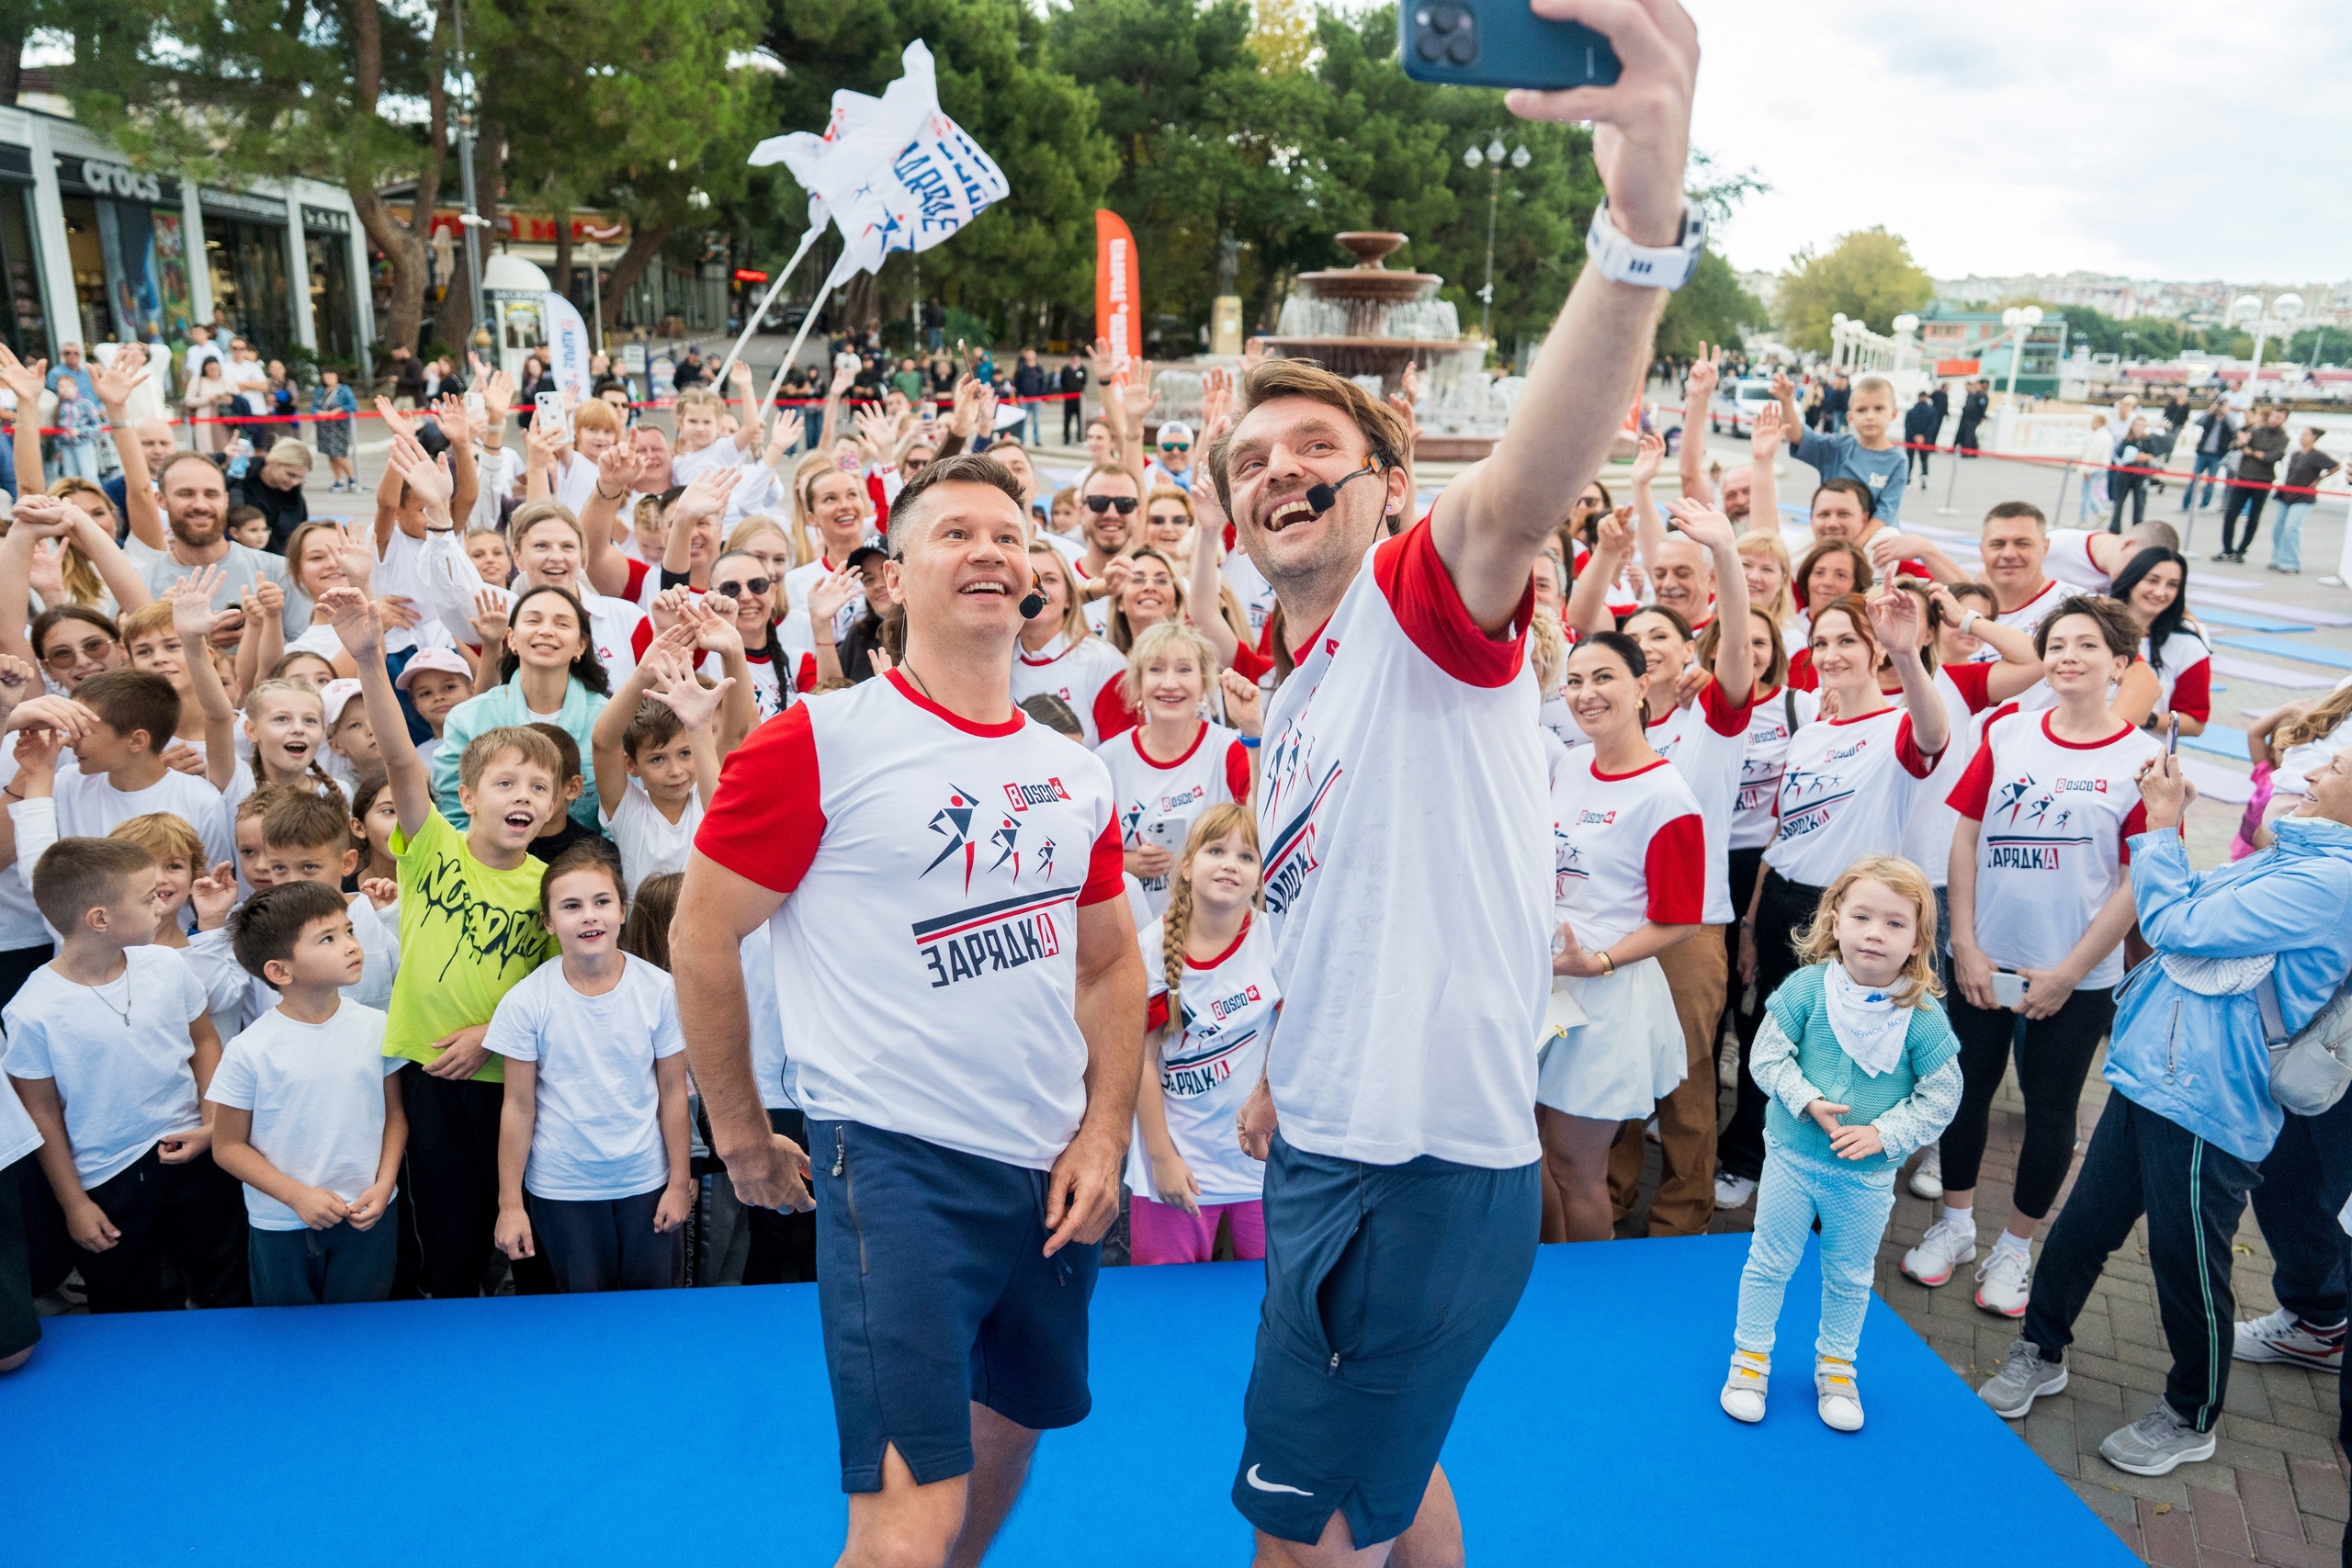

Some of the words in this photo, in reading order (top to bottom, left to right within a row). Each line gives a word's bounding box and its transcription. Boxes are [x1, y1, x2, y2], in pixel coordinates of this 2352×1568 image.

[1003, 782, 1059, 813] BOSCO
[2055, 778, 2093, 794] BOSCO
[1161, 792, 1193, 812] BOSCO
[1987, 847, 2059, 870] АРЯДКА
[921, 912, 1060, 988] ЗАРЯДКА
[1211, 992, 1249, 1021] BOSCO
[1887, 1015, 1905, 1029] МОР
